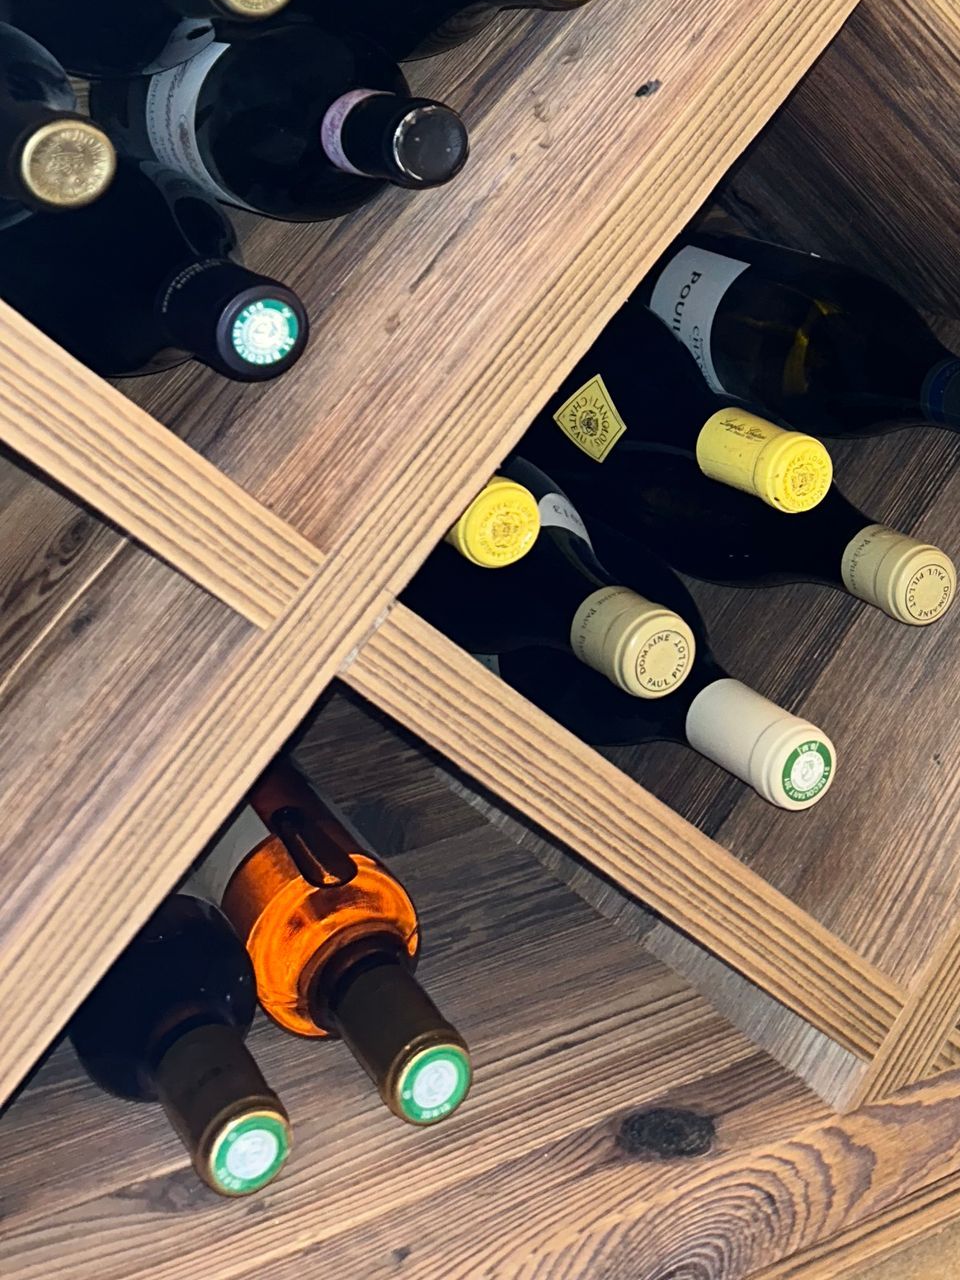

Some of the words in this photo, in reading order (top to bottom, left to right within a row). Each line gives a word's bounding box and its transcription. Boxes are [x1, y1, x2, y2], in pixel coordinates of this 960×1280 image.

[568, 396, 588, 445] CHATEAU
[592, 397, 610, 447] LANGLOIS
[908, 572, 925, 608] PILLOT
[926, 568, 946, 582] PAUL
[918, 585, 950, 617] DOMAINE
[639, 633, 671, 675] DOMAINE
[646, 677, 671, 688] PAUL
[671, 639, 687, 679] PILLOT
